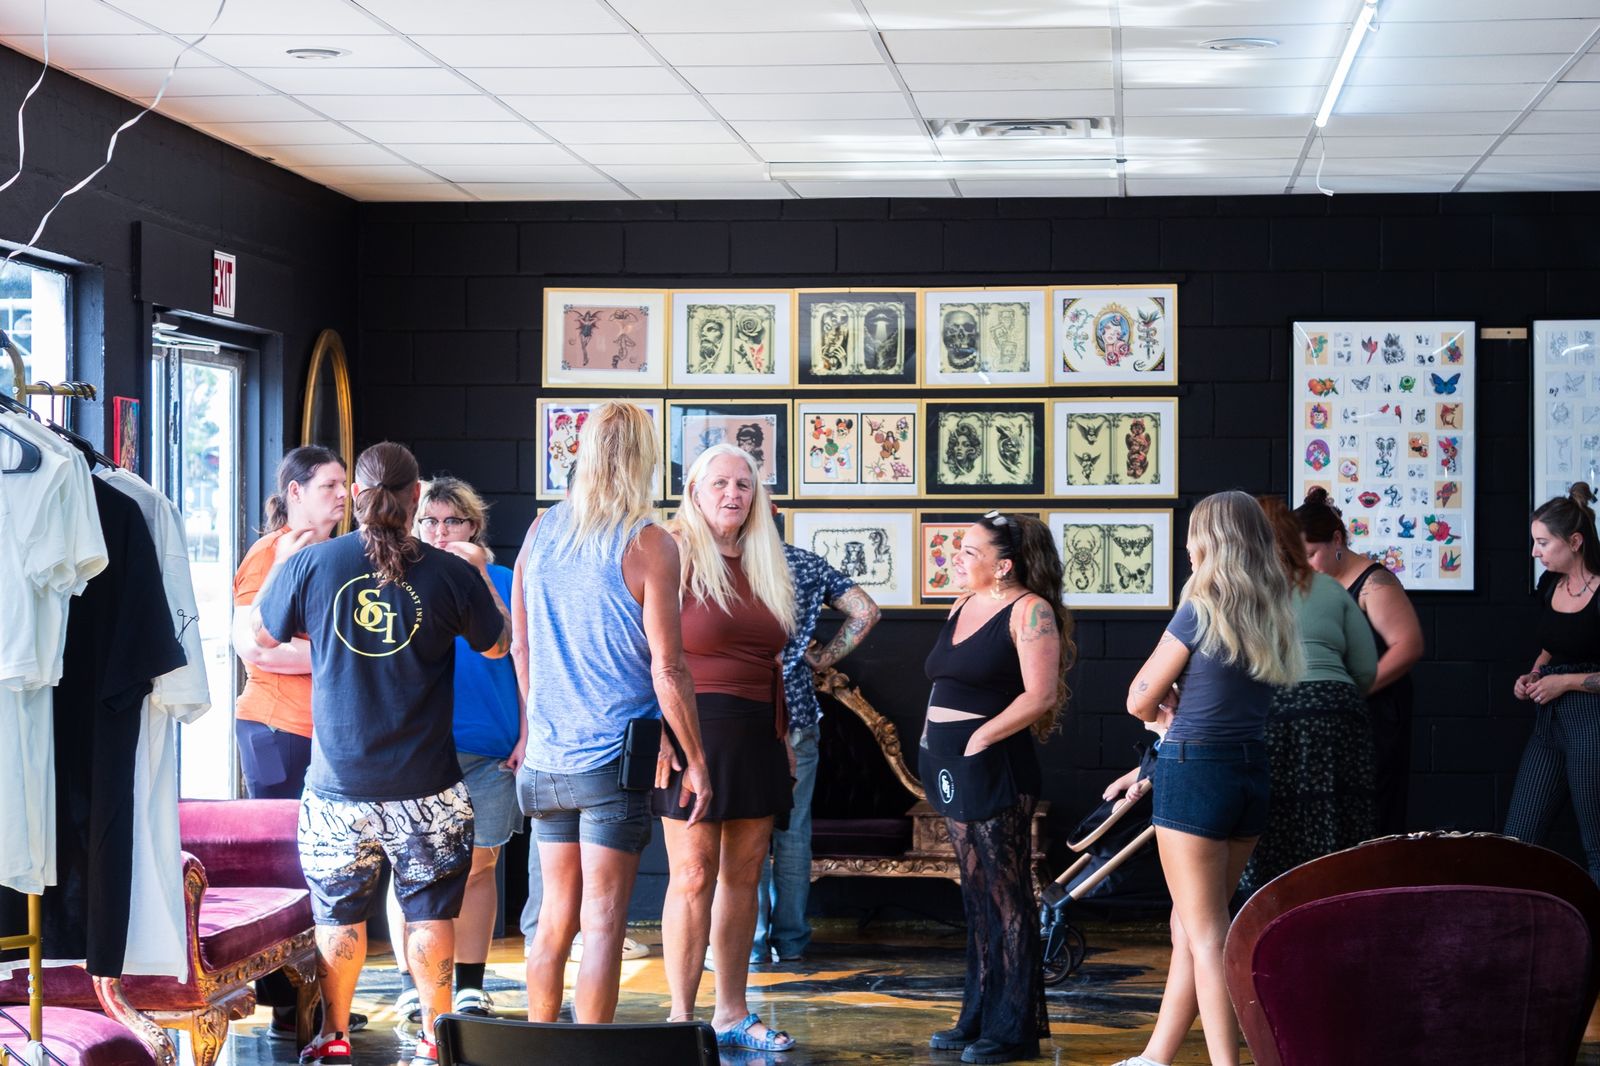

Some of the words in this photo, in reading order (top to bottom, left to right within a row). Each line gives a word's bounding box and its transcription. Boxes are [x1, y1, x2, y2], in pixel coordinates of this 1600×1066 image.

[214, 258, 233, 309] EXIT
[401, 581, 421, 605] COAST
[415, 607, 423, 623] INK
